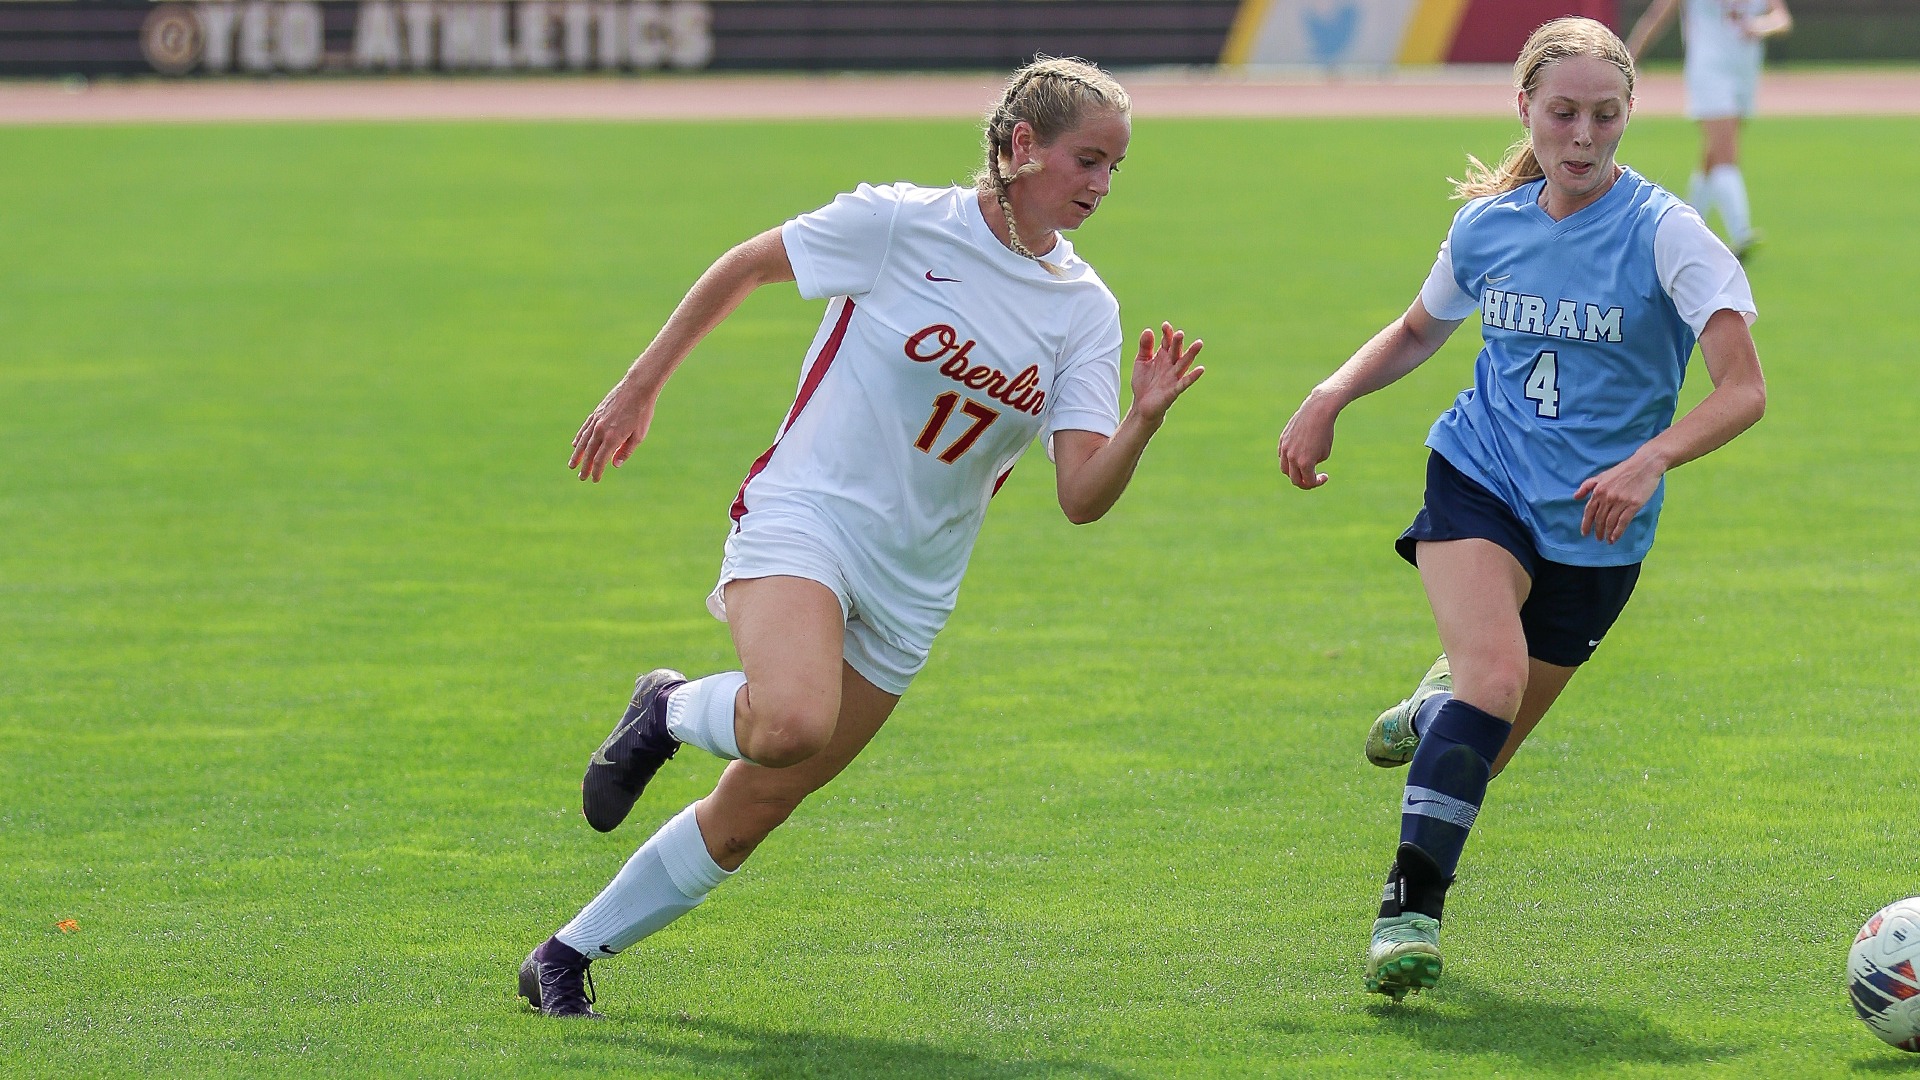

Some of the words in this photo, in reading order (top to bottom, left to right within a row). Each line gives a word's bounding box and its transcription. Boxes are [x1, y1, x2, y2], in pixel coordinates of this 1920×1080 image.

[1482, 288, 1624, 343] HIRAM
[904, 323, 1047, 417] Oberlin
[1524, 350, 1560, 420] 4
[914, 390, 1001, 466] 17
